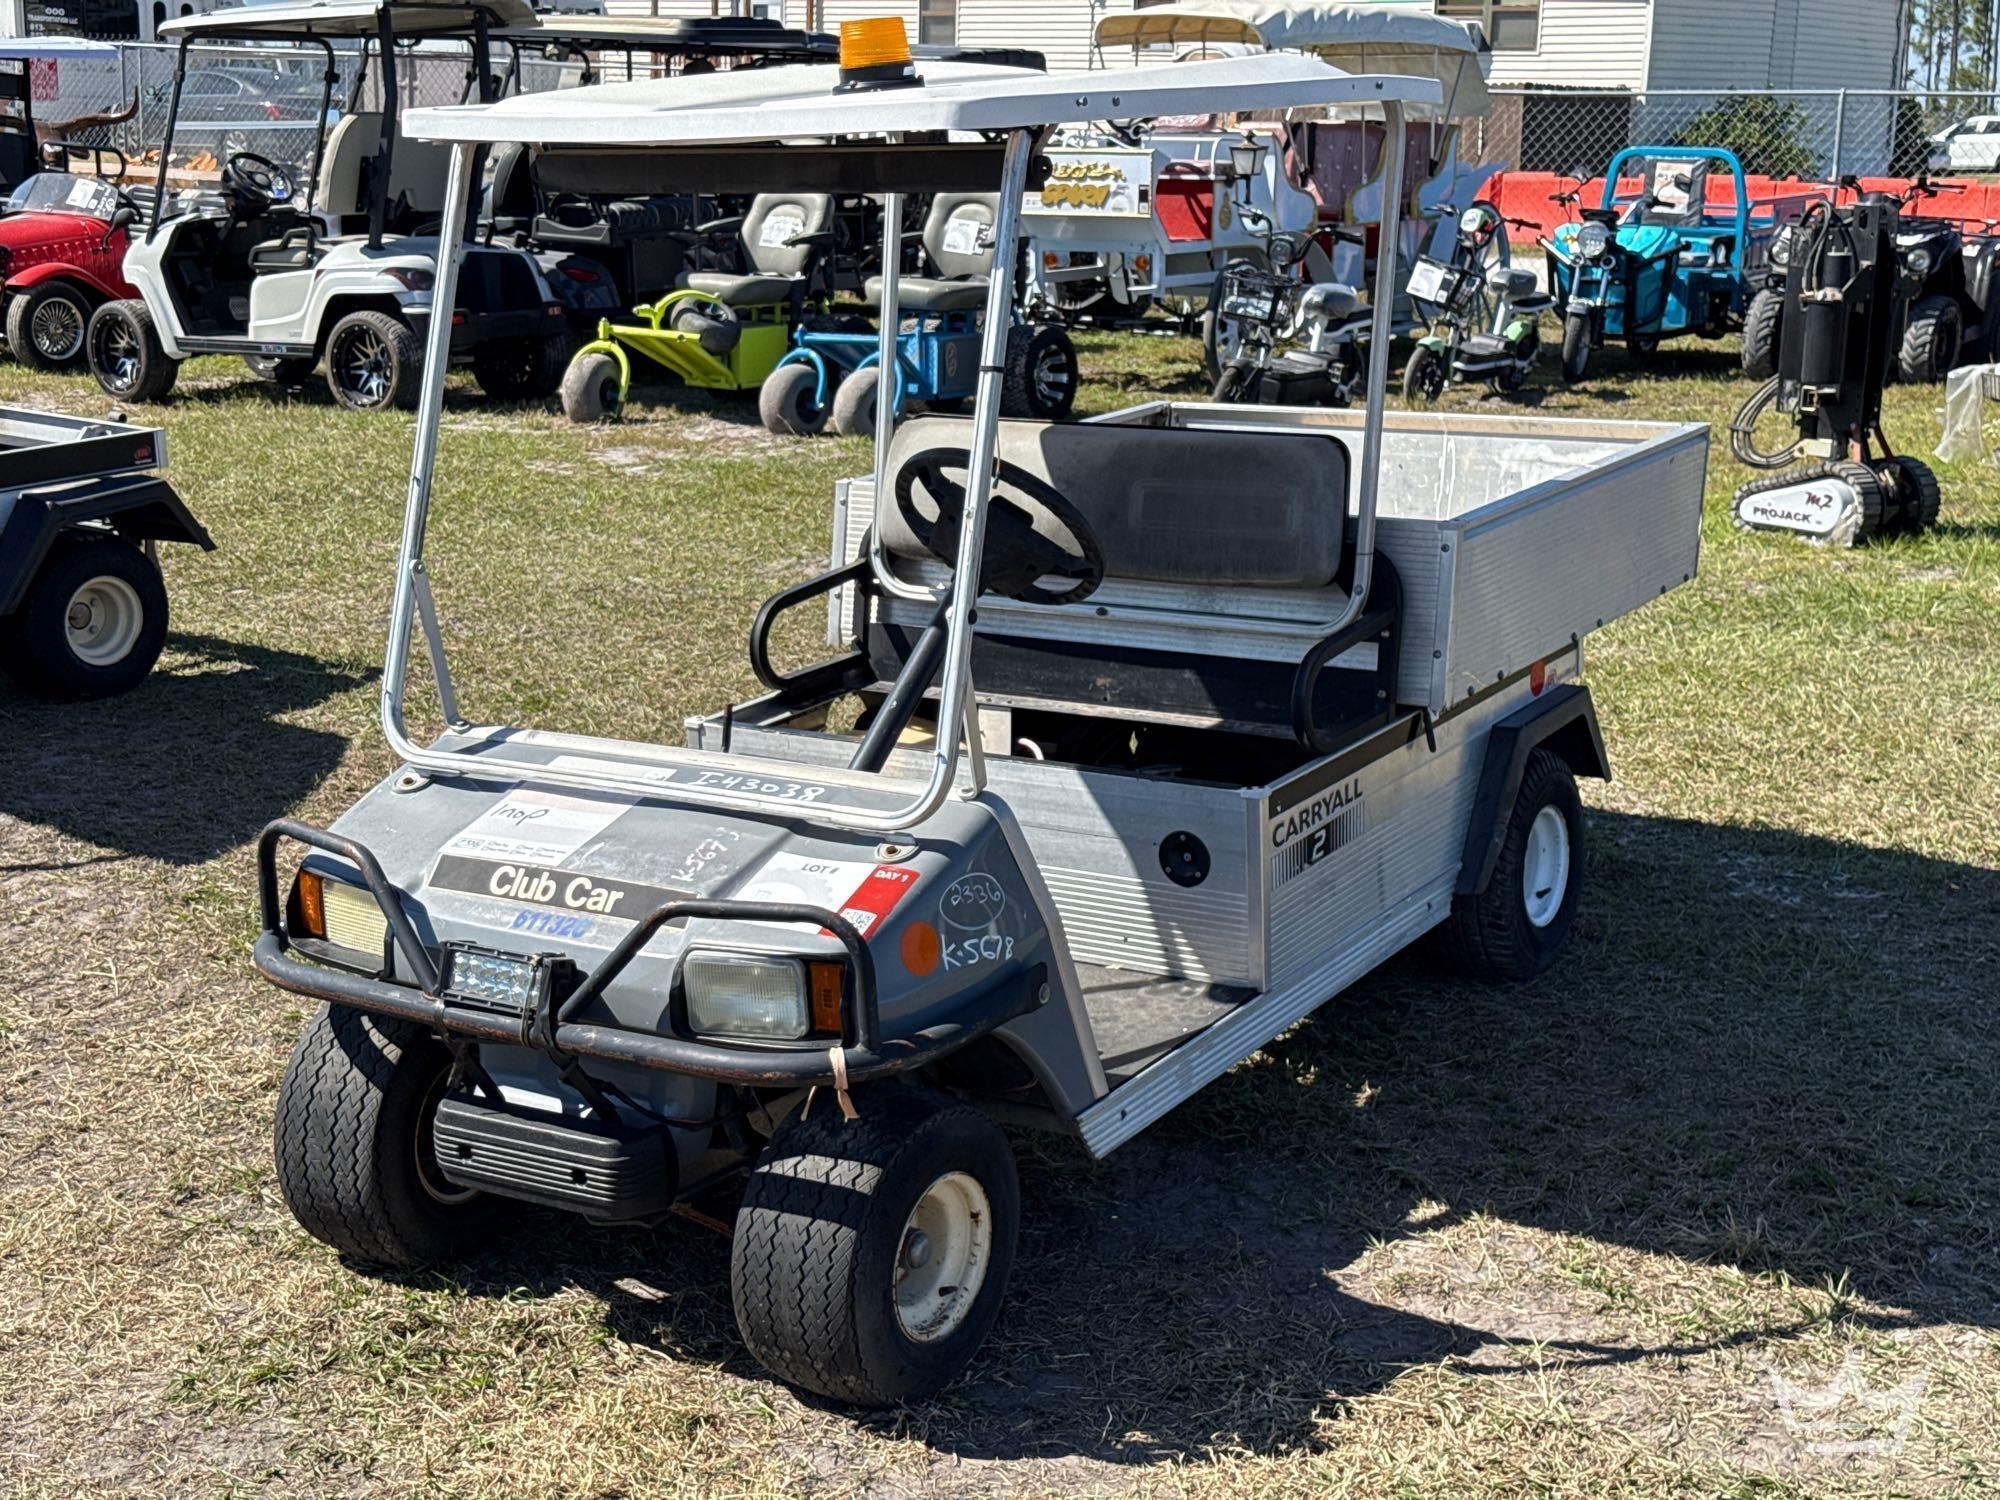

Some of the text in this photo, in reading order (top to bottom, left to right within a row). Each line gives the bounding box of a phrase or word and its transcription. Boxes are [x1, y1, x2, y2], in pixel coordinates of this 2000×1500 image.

[1753, 506, 1813, 524] PROJACK
[1273, 779, 1363, 848] CARRYALL
[1311, 829, 1327, 862] 2
[801, 863, 830, 874] LOT
[874, 869, 909, 883] DAY 1
[489, 865, 624, 913] Club Car
